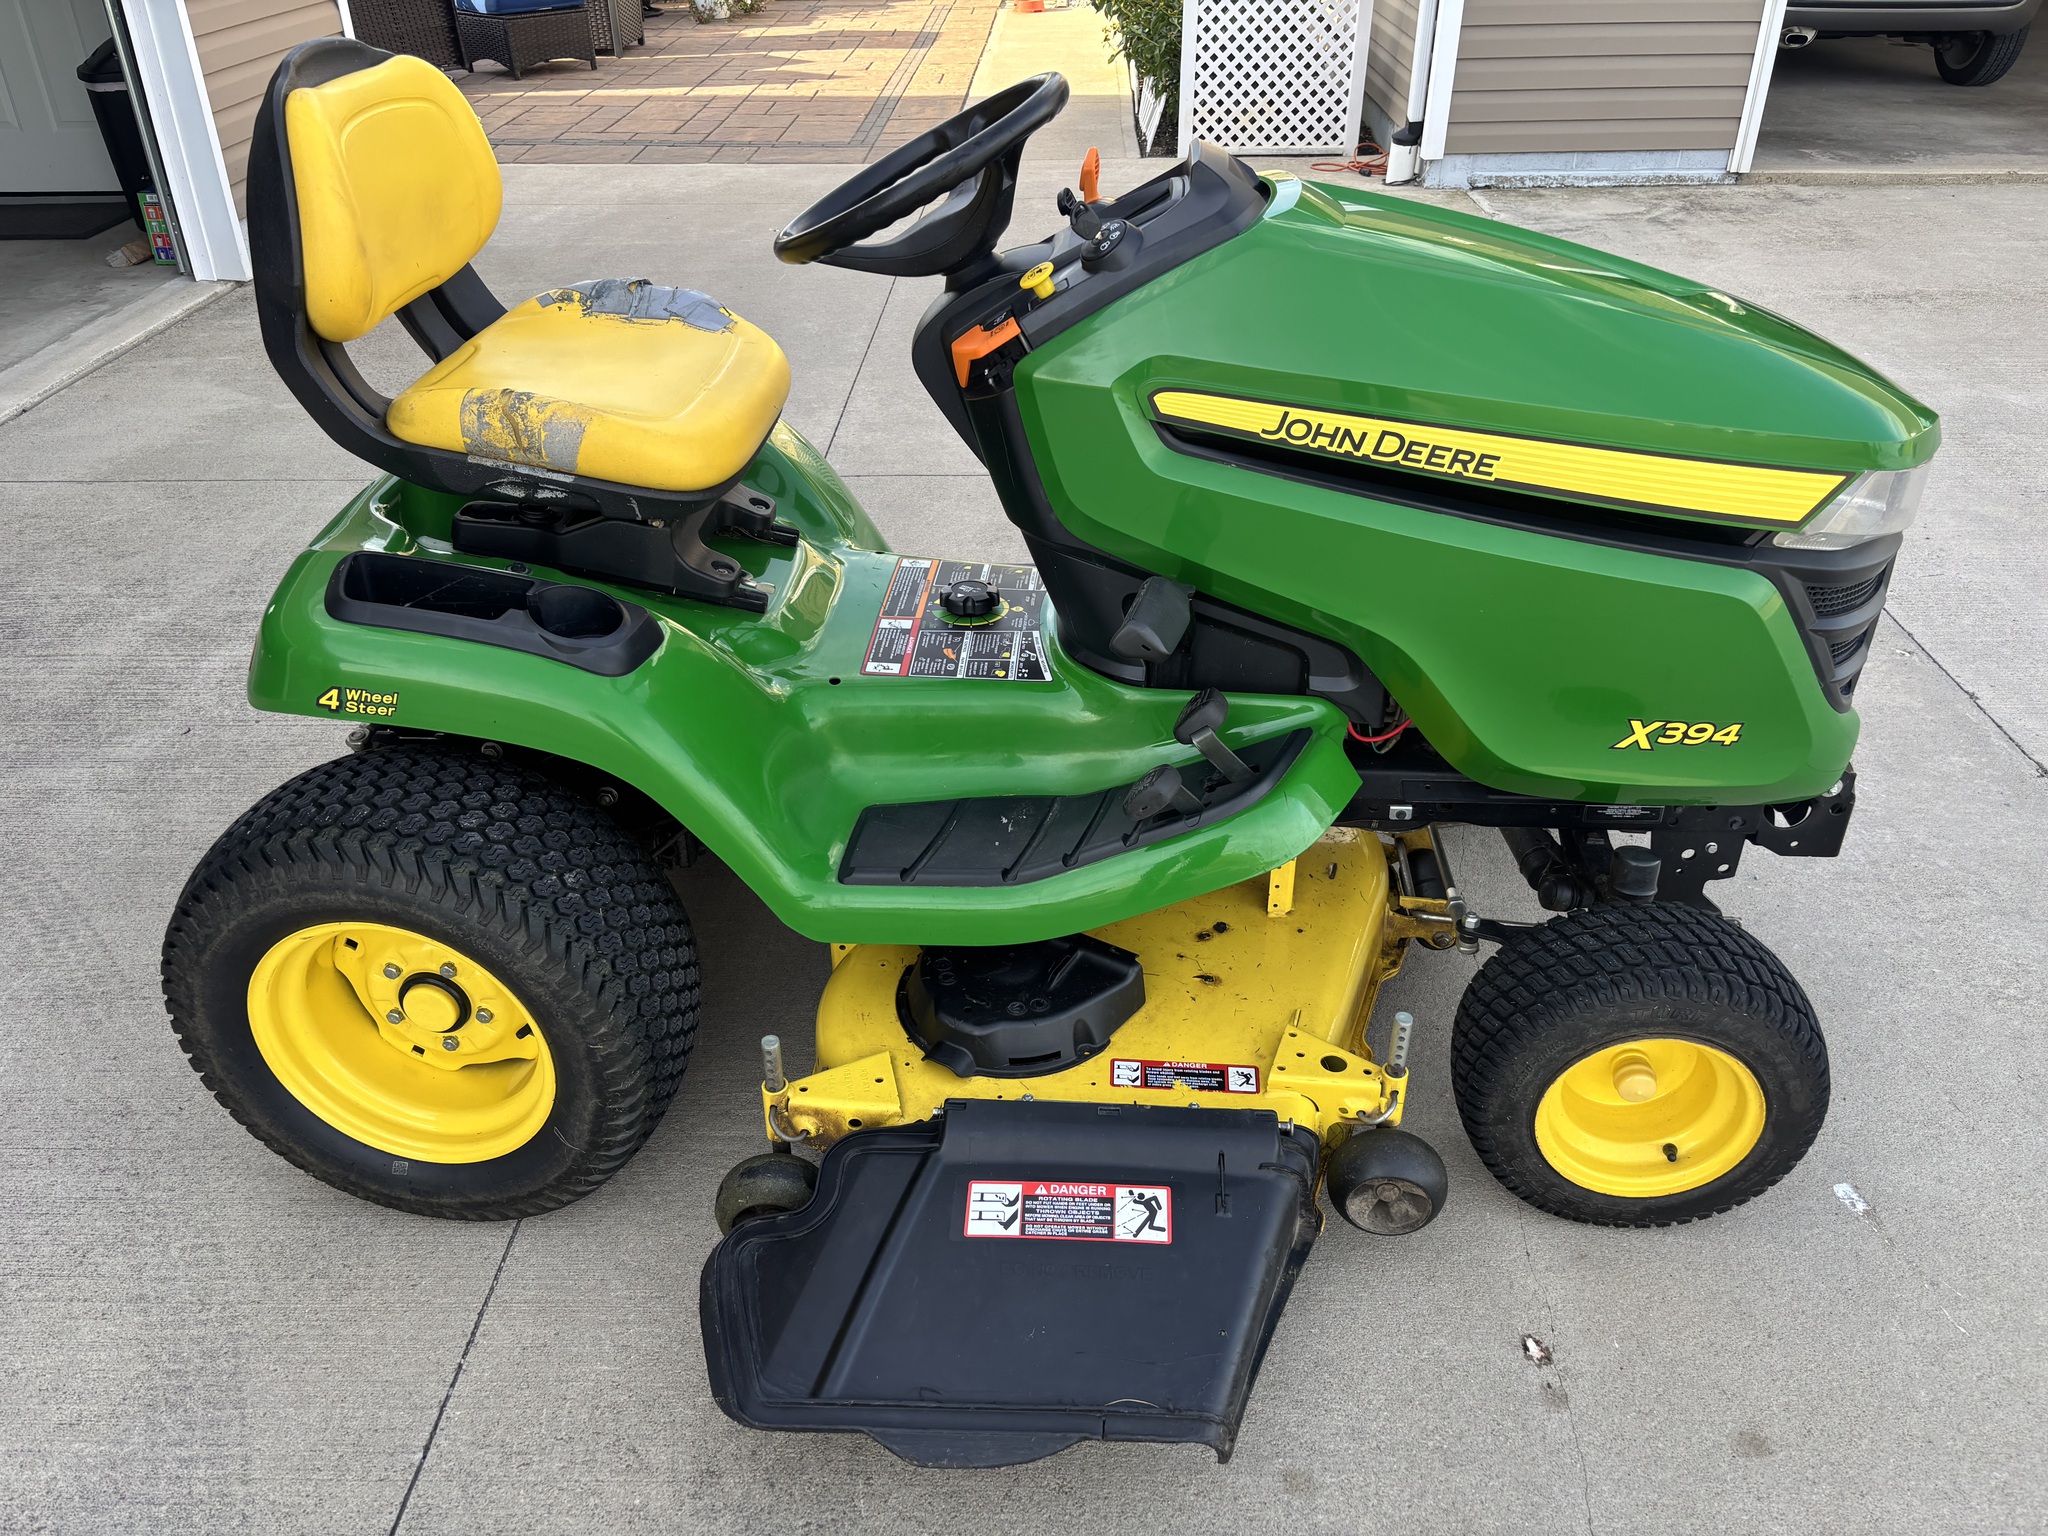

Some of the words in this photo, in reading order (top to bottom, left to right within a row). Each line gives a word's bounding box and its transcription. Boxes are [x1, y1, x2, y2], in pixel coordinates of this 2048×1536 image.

[1261, 411, 1368, 453] JOHN
[1372, 430, 1501, 478] DEERE
[318, 688, 340, 710] 4
[345, 689, 398, 705] Wheel
[345, 701, 396, 716] Steer
[1610, 719, 1743, 750] X394
[1050, 1184, 1106, 1195] DANGER
[1074, 1265, 1153, 1281] REMOVE
